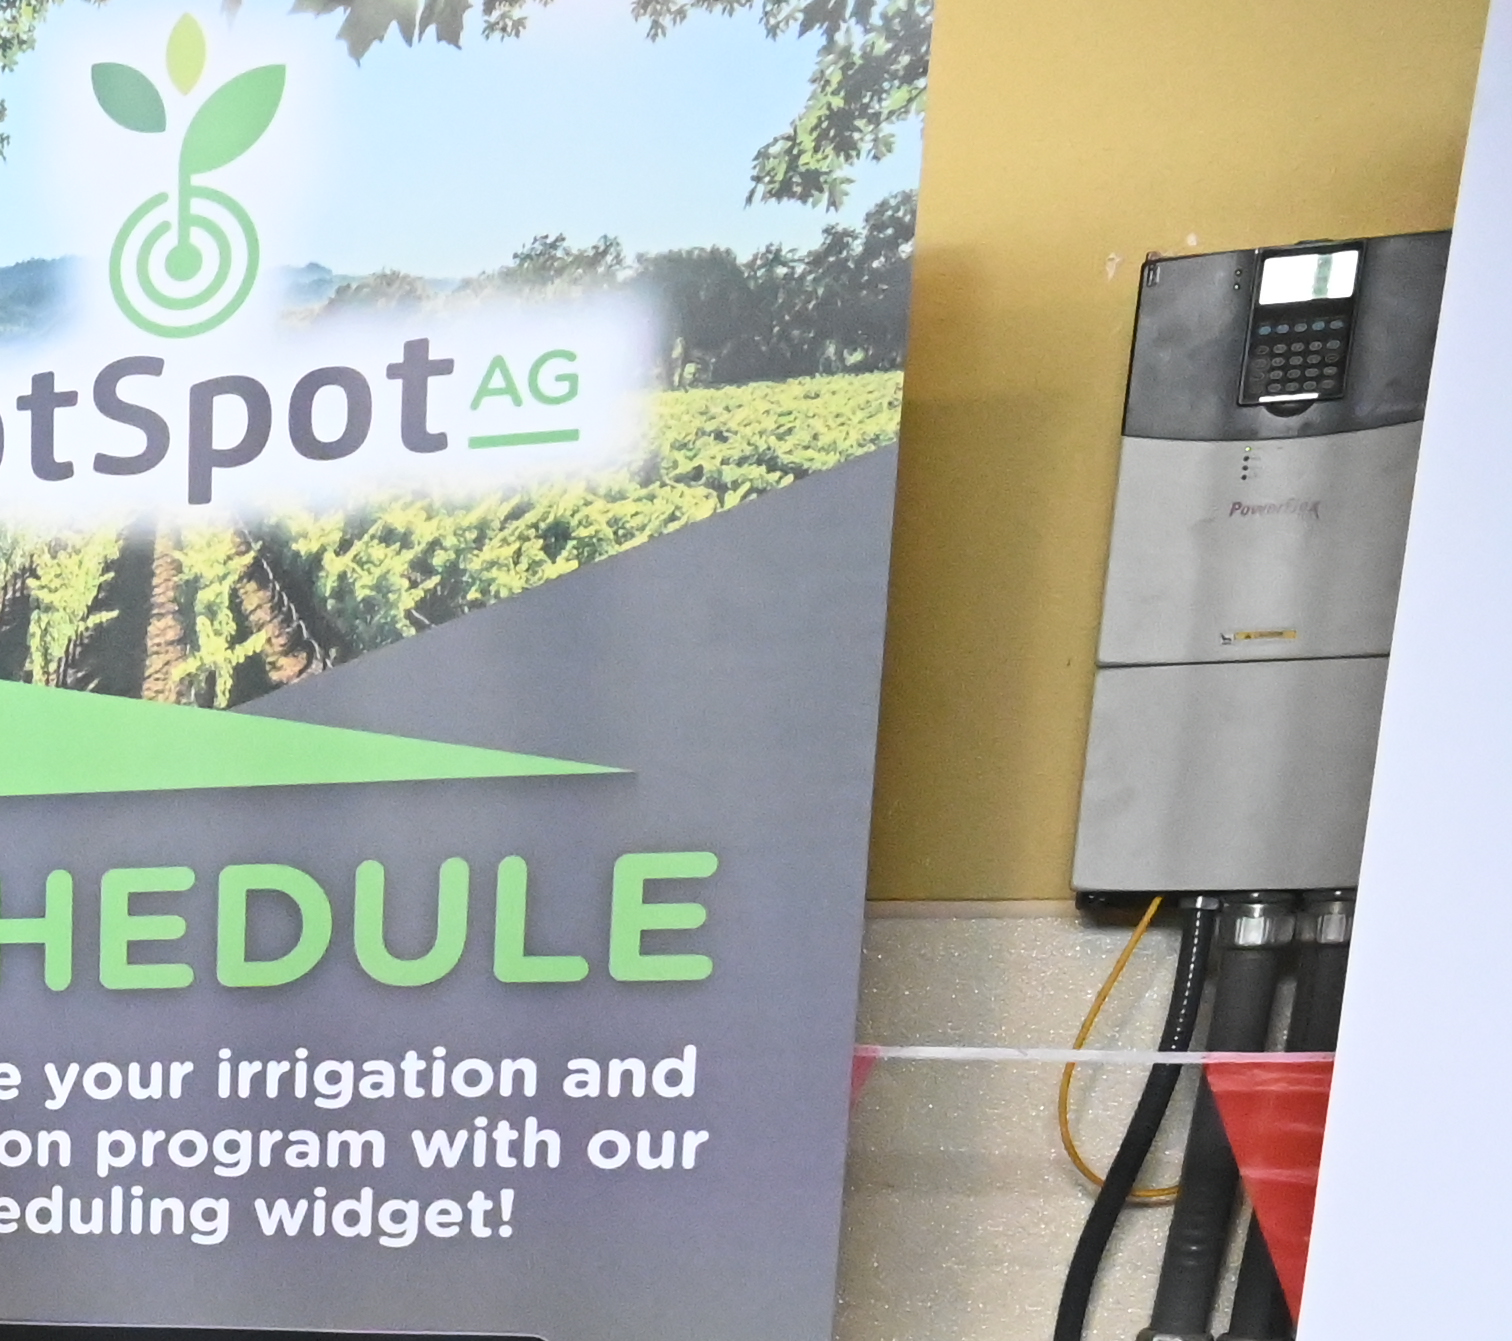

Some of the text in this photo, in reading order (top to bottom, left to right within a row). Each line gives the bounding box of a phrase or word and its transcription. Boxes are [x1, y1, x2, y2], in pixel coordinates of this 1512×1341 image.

[469, 349, 580, 411] AG
[44, 1054, 194, 1113] your
[216, 1045, 541, 1111] irrigation
[561, 1044, 698, 1098] and
[96, 1127, 385, 1177] program
[409, 1115, 561, 1168] with
[585, 1127, 710, 1171] our
[252, 1184, 517, 1248] widget!
